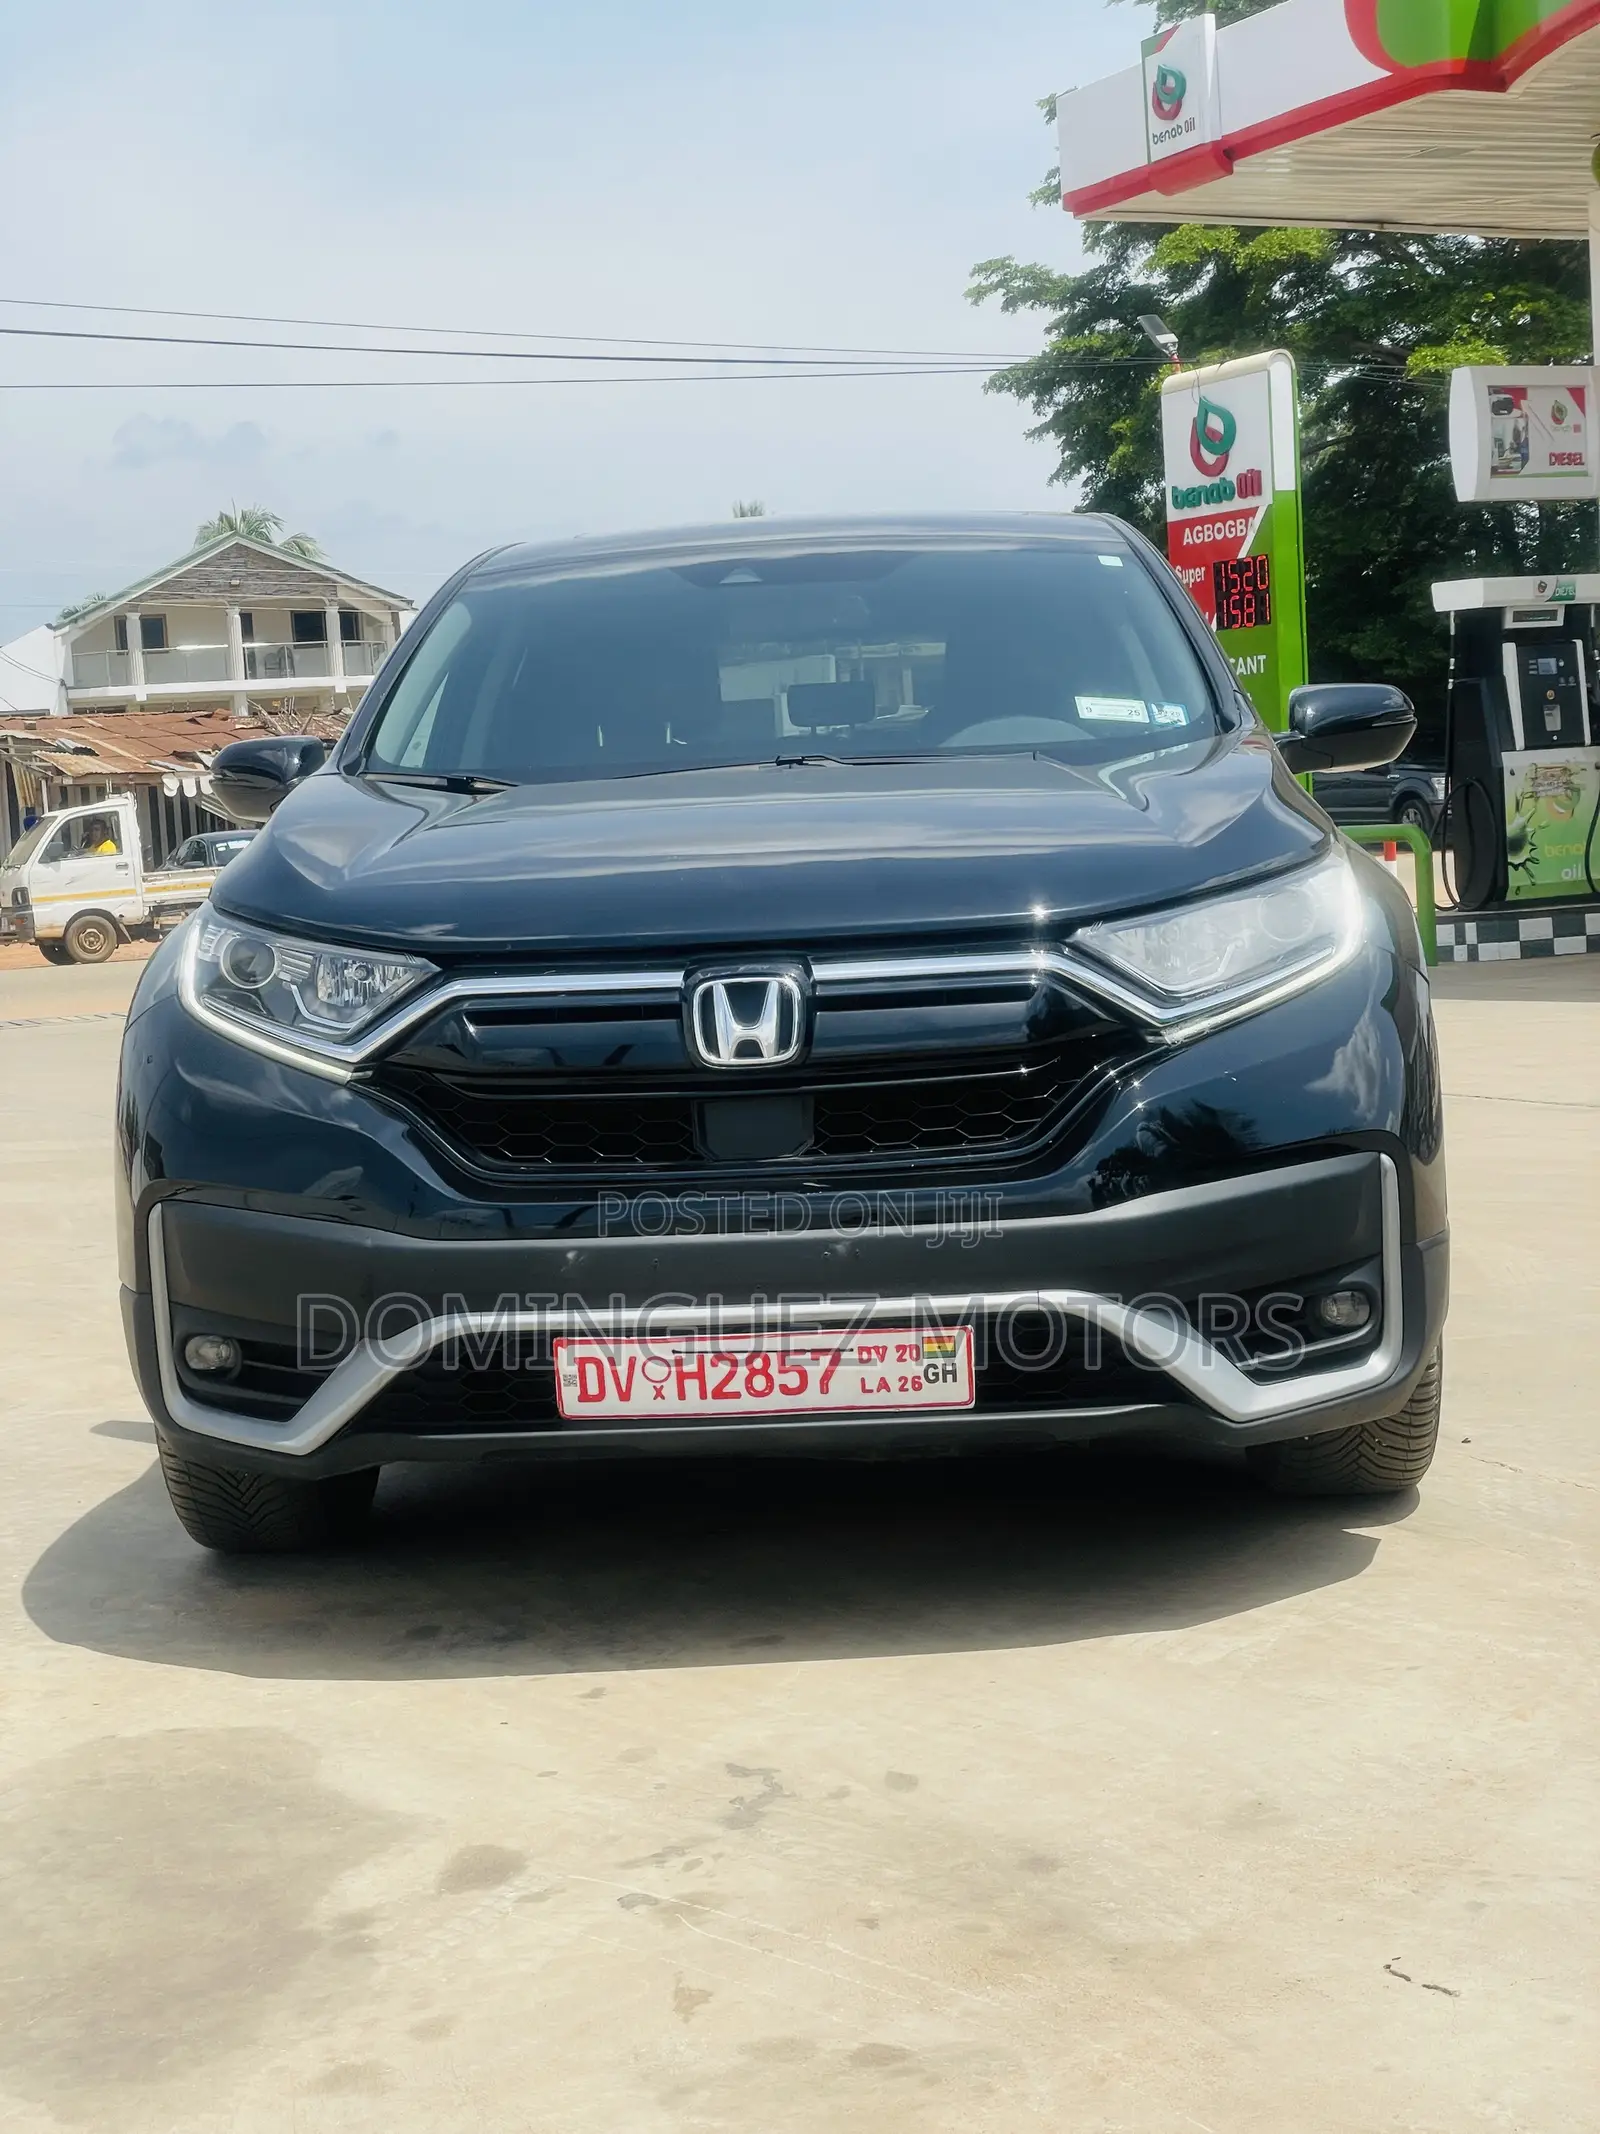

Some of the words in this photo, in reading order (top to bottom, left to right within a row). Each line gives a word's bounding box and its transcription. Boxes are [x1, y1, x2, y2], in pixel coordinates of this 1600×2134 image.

[1152, 124, 1183, 145] benab
[1549, 452, 1585, 466] DIESEL
[1172, 477, 1236, 509] benab
[1175, 565, 1206, 588] Super
[1544, 841, 1586, 858] bena
[1561, 862, 1581, 880] oil
[857, 1344, 887, 1364] DV
[895, 1343, 921, 1363] 20
[576, 1356, 636, 1403] DV
[676, 1348, 843, 1401] H2857
[923, 1362, 958, 1384] GH
[860, 1376, 891, 1394] LA
[897, 1374, 923, 1392] 26
